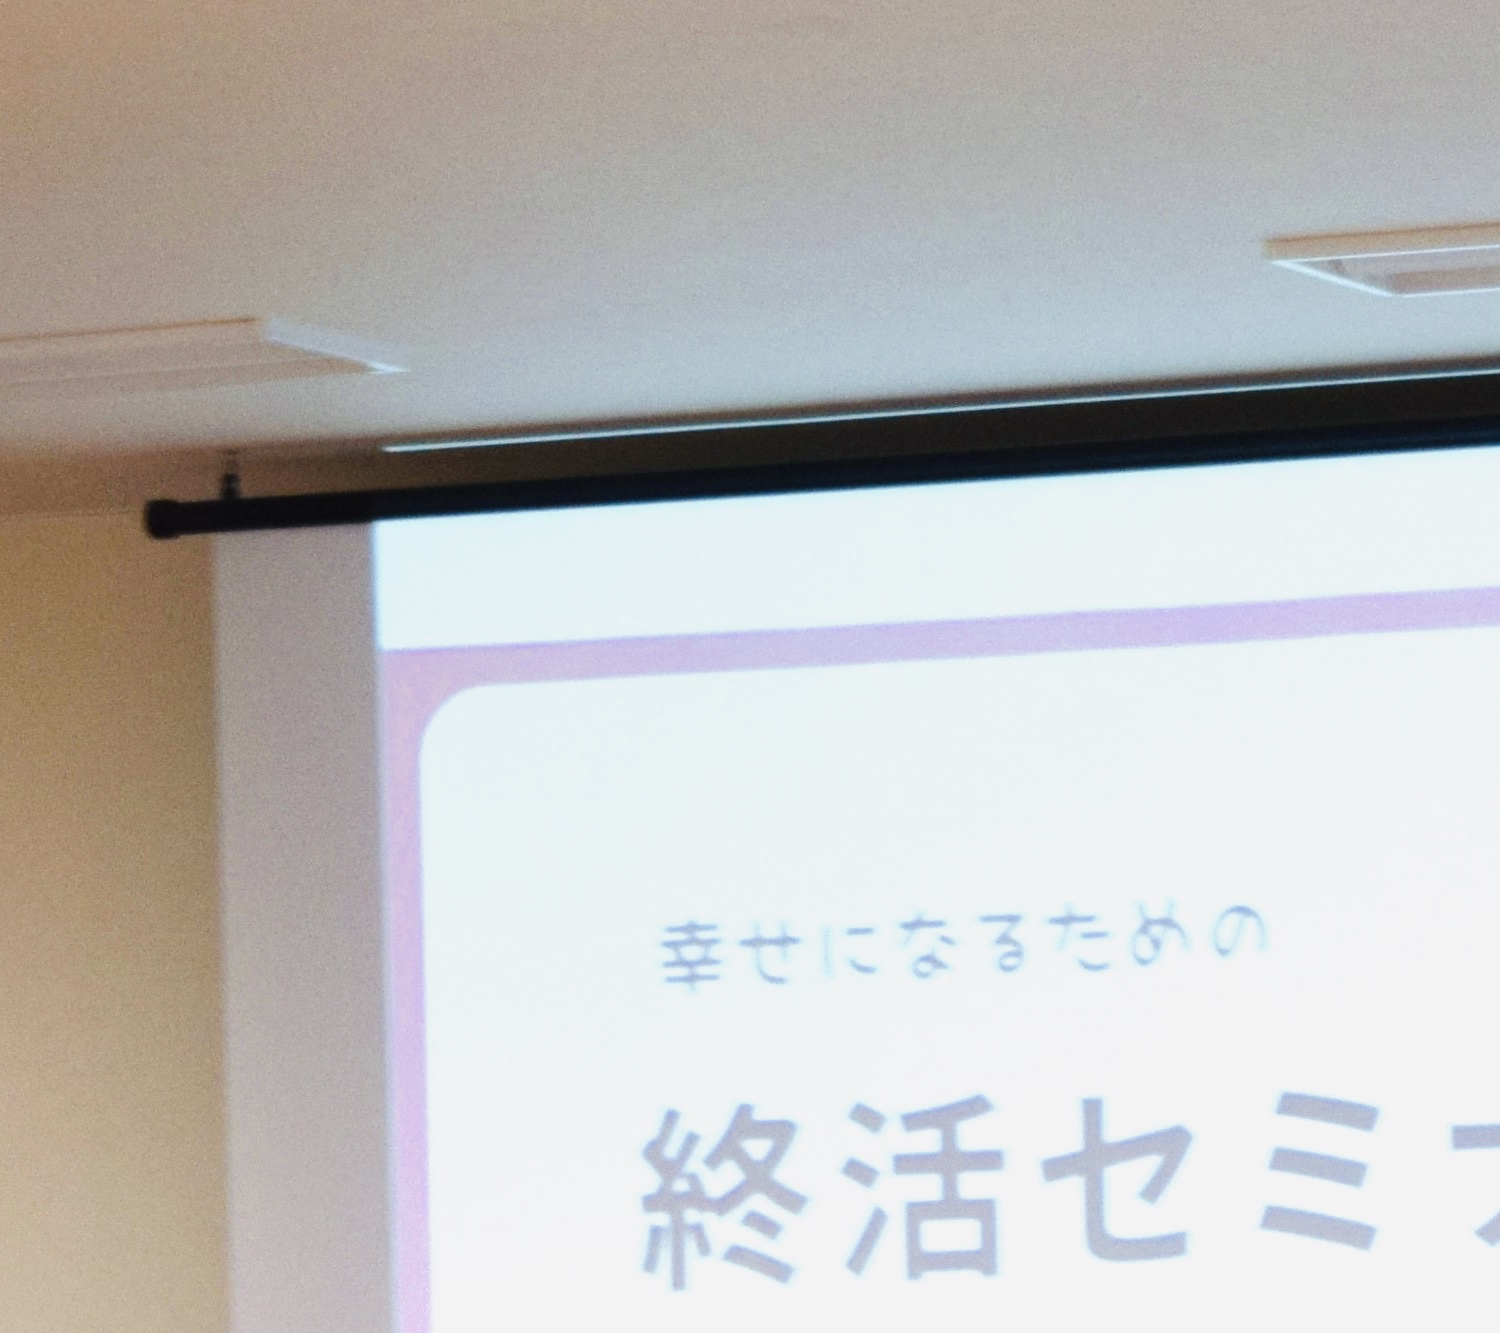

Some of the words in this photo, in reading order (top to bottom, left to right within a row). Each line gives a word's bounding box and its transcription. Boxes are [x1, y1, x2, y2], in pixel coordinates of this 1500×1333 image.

[658, 899, 1268, 994] 幸せになるための
